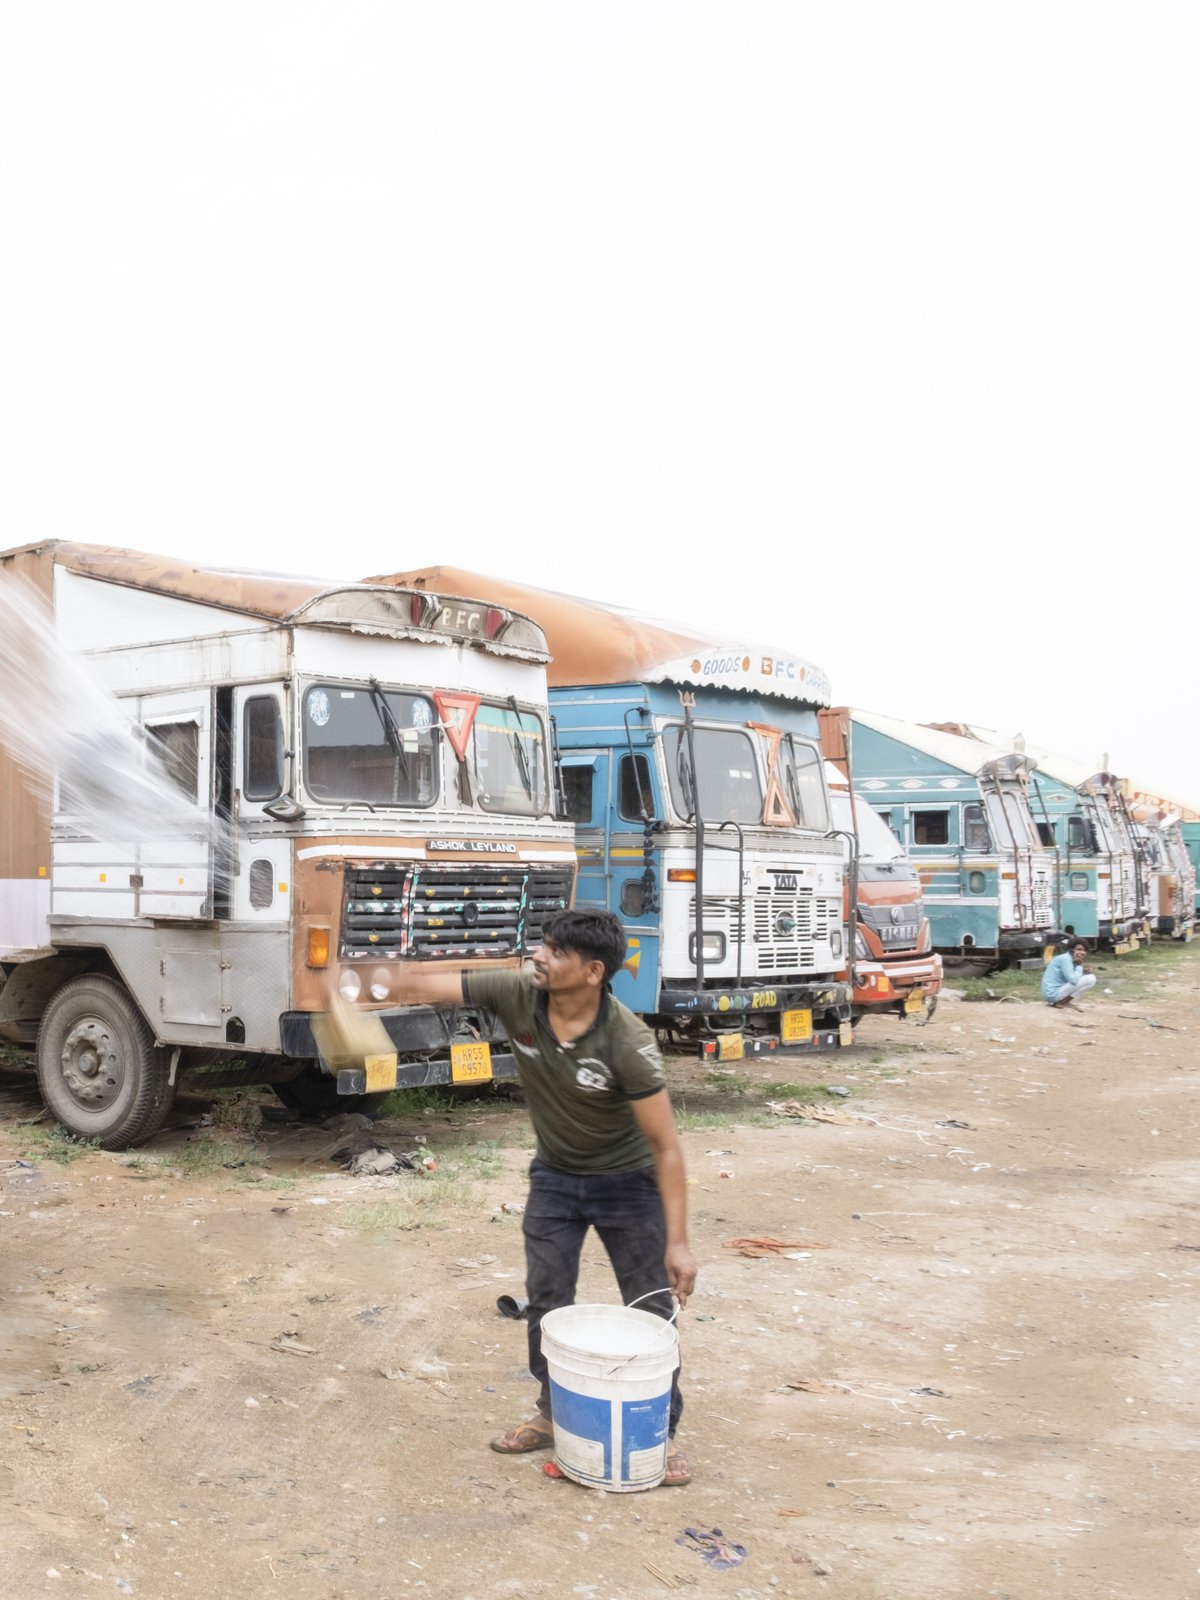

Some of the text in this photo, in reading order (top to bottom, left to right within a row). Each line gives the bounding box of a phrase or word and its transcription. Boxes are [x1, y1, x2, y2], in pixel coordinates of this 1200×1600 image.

[703, 656, 741, 676] GOODS
[760, 656, 796, 679] BFC
[430, 841, 518, 853] ASHOK LEYLAND
[773, 874, 798, 888] TATA
[751, 990, 777, 1009] ROAD
[462, 1047, 483, 1061] HR55
